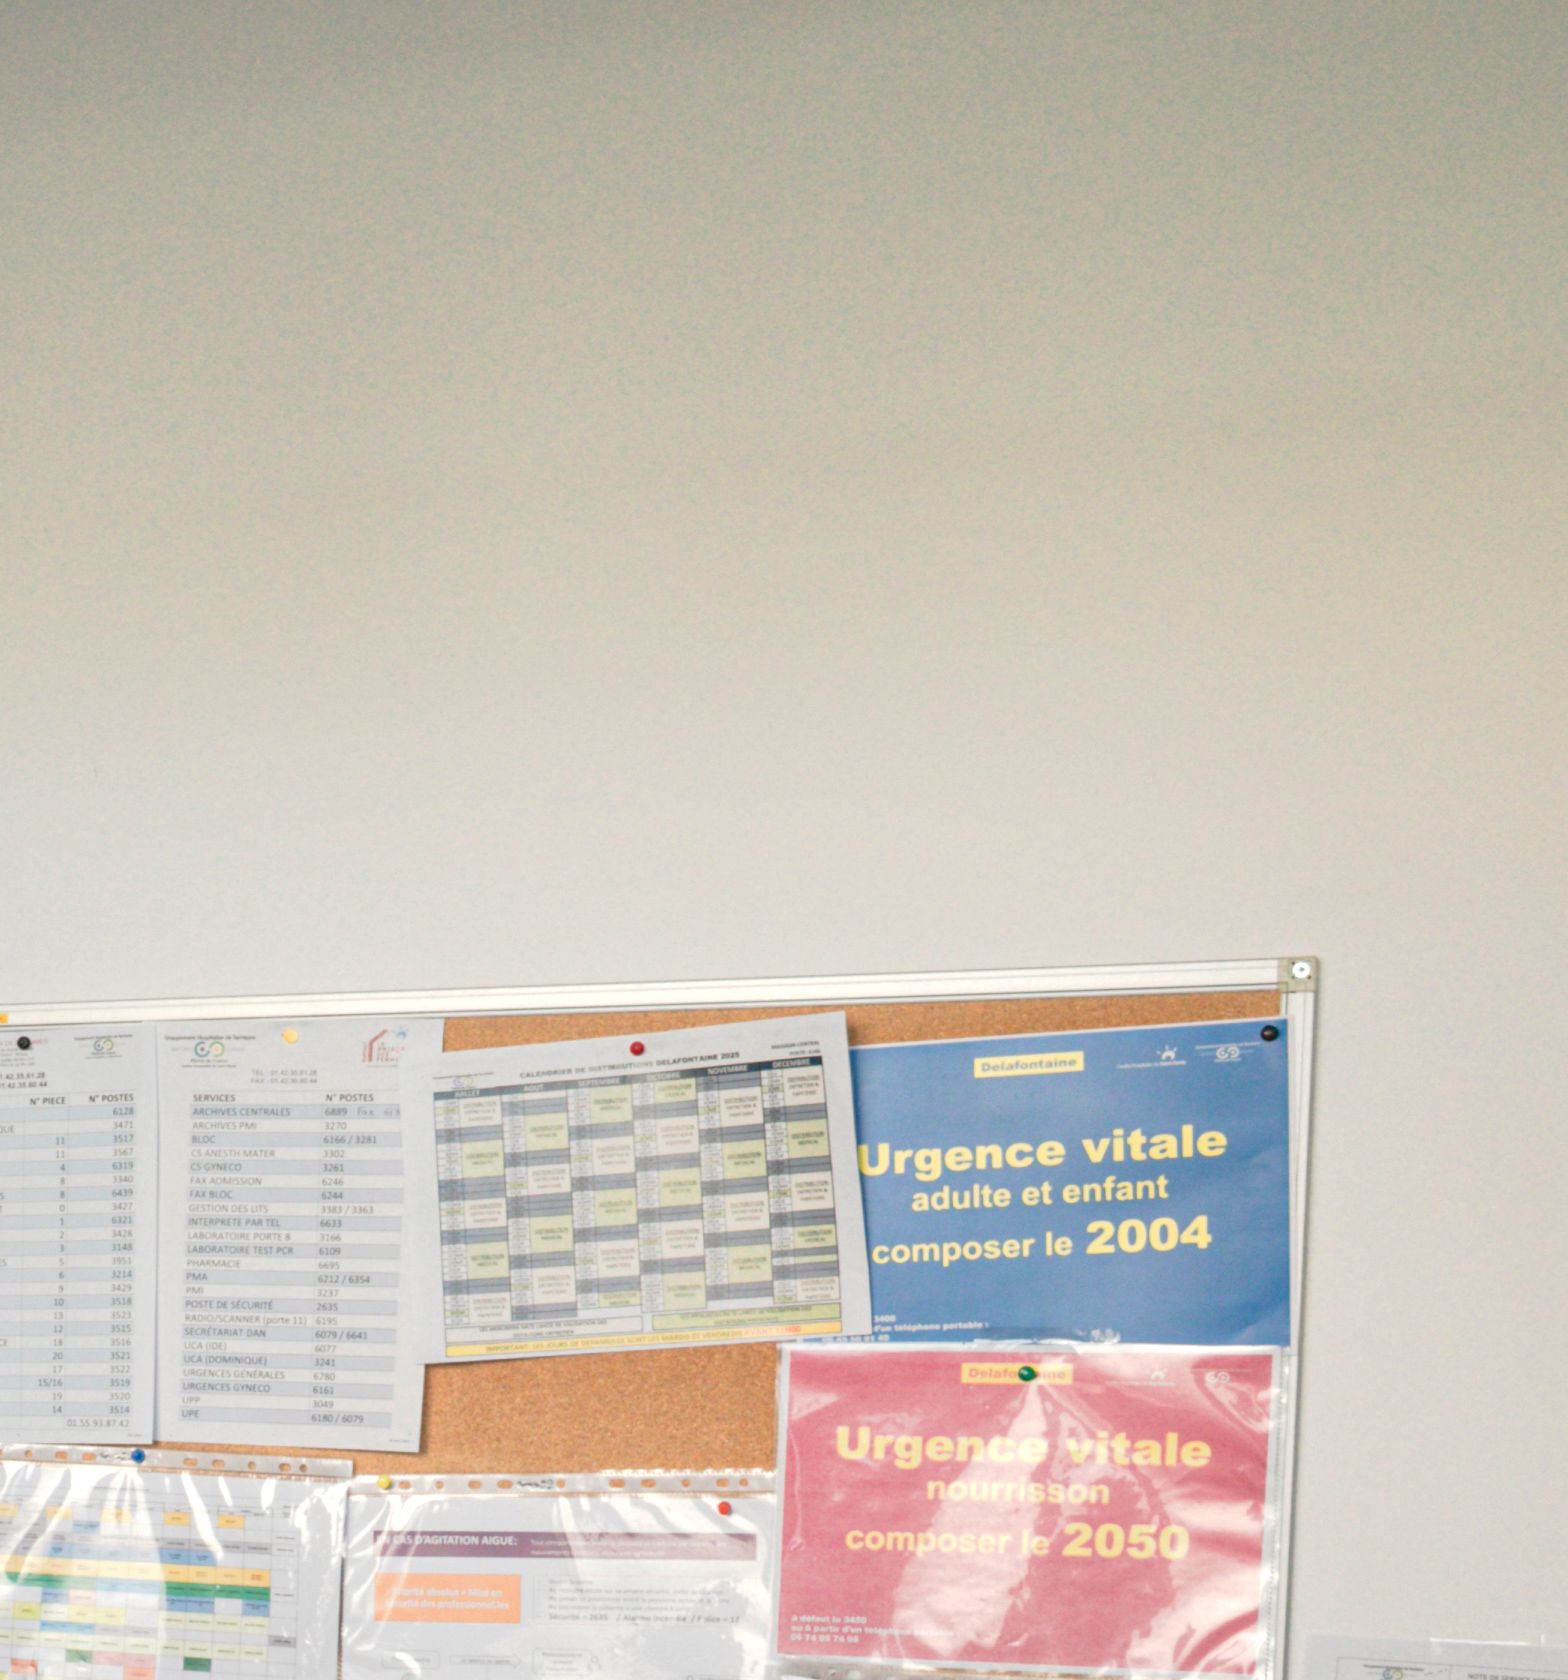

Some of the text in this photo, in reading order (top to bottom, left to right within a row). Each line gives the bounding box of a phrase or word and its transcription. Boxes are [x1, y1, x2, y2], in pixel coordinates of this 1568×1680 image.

[655, 1054, 718, 1067] DELAFONTAINE
[720, 1051, 740, 1061] 2025
[980, 1056, 1077, 1073] Delafontaine
[42, 1096, 65, 1105] PIECE
[102, 1094, 134, 1103] POSTES
[193, 1094, 235, 1102] SERVICES
[339, 1094, 374, 1102] POSTES
[113, 1107, 134, 1116] 6128
[193, 1108, 291, 1116] ARCHIVES CENTRALES
[191, 1135, 215, 1144] BLOC
[858, 1124, 1228, 1182] Urgence vitale
[204, 1163, 242, 1172] GYNECO
[190, 1177, 262, 1186] FAX ADMISSION
[911, 1174, 1169, 1213] adulte et enfant
[189, 1205, 268, 1213] GESTION DES LITS
[188, 1218, 280, 1227] INTERPRETE PAR TEL
[872, 1214, 1212, 1268] composer le 2004
[187, 1246, 250, 1255] LABORATOIRE
[253, 1246, 274, 1255] TEST
[187, 1259, 240, 1268] PHARMACIE
[185, 1300, 273, 1310] POSTE DE SÉCURITÉ
[184, 1327, 267, 1338] SECRÉTARIAT DAN
[967, 1367, 1066, 1381] Delafoine
[183, 1382, 270, 1393] URGENCES GYNECO
[835, 1425, 1213, 1470] Urgence vitale
[927, 1477, 1109, 1506] nourrisson
[415, 1534, 480, 1546] D'AGITATION
[844, 1521, 1190, 1560] composer le 2050
